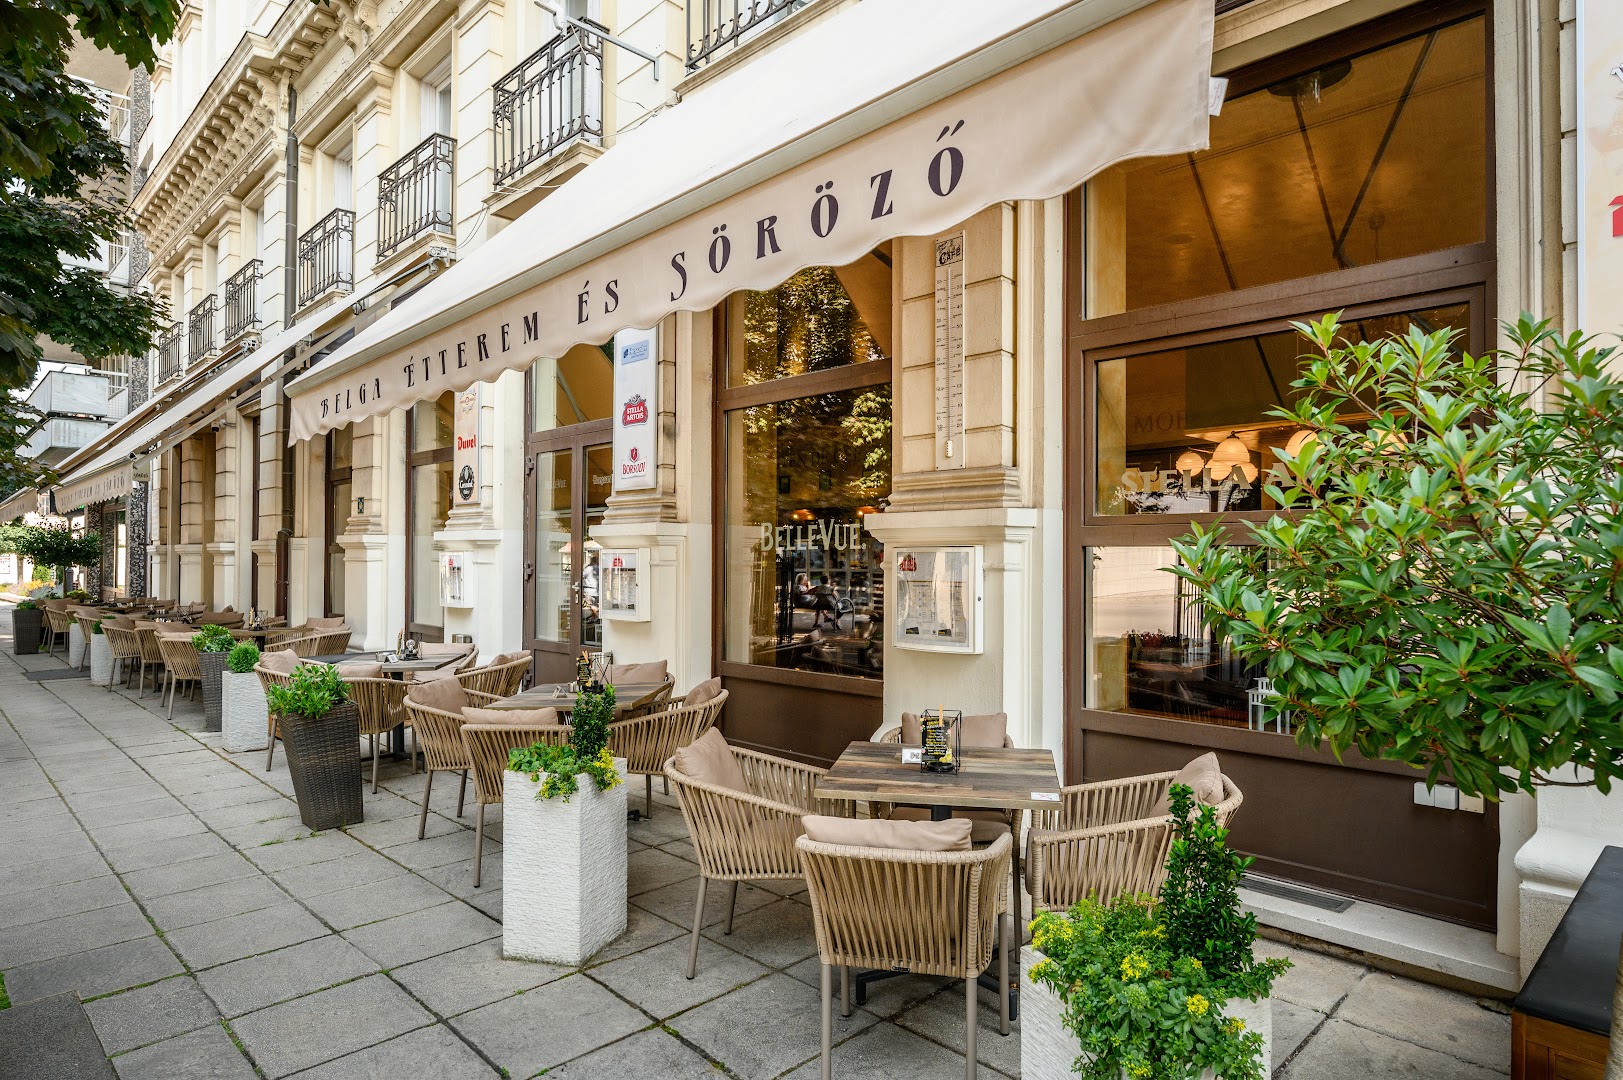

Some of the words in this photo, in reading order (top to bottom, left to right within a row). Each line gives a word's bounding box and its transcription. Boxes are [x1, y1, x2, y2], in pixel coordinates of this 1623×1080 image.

[320, 377, 381, 419] BELGA
[403, 311, 540, 388] ÉTTEREM
[577, 279, 619, 325] ÉS
[670, 119, 965, 302] SÖRÖZŐ
[626, 405, 644, 415] STELLA
[626, 412, 644, 421] ARTOIS
[457, 434, 477, 451] Duvel
